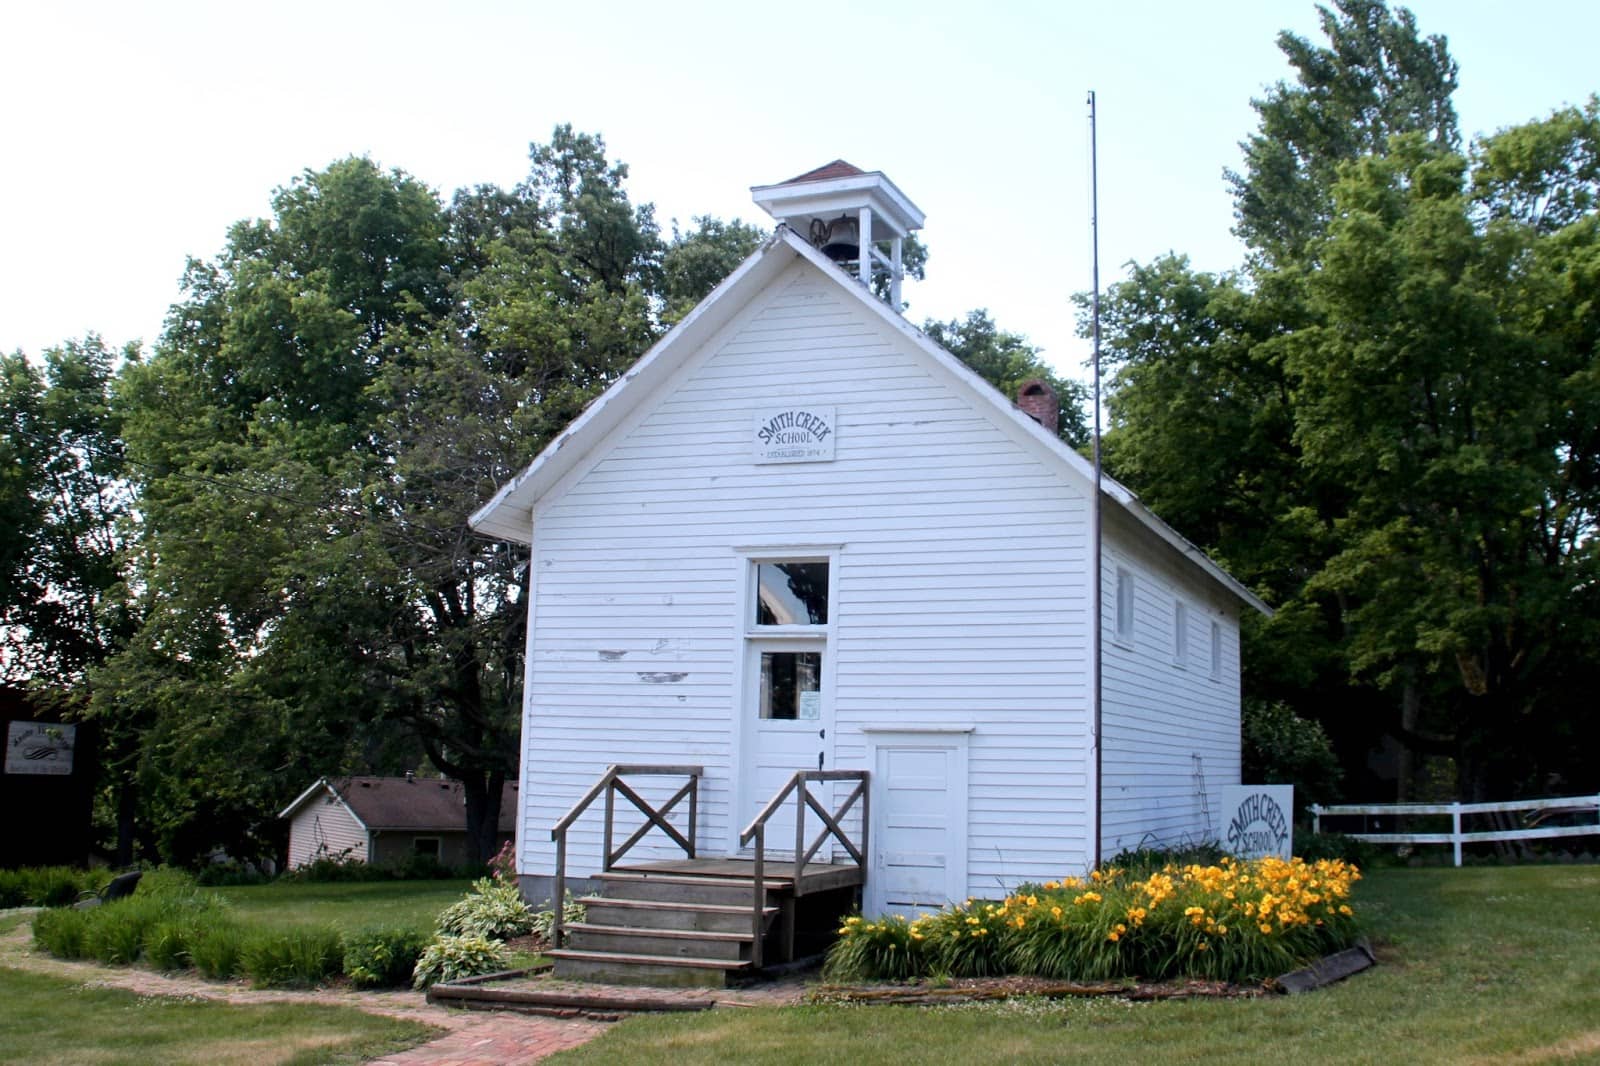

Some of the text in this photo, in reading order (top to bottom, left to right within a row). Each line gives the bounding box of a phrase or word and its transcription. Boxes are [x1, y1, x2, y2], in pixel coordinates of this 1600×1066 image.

[758, 411, 831, 445] SMITH CREEK
[775, 432, 812, 444] SCHOOL
[1228, 793, 1288, 854] SMITH CREEK
[1242, 831, 1274, 852] SCHOOL
